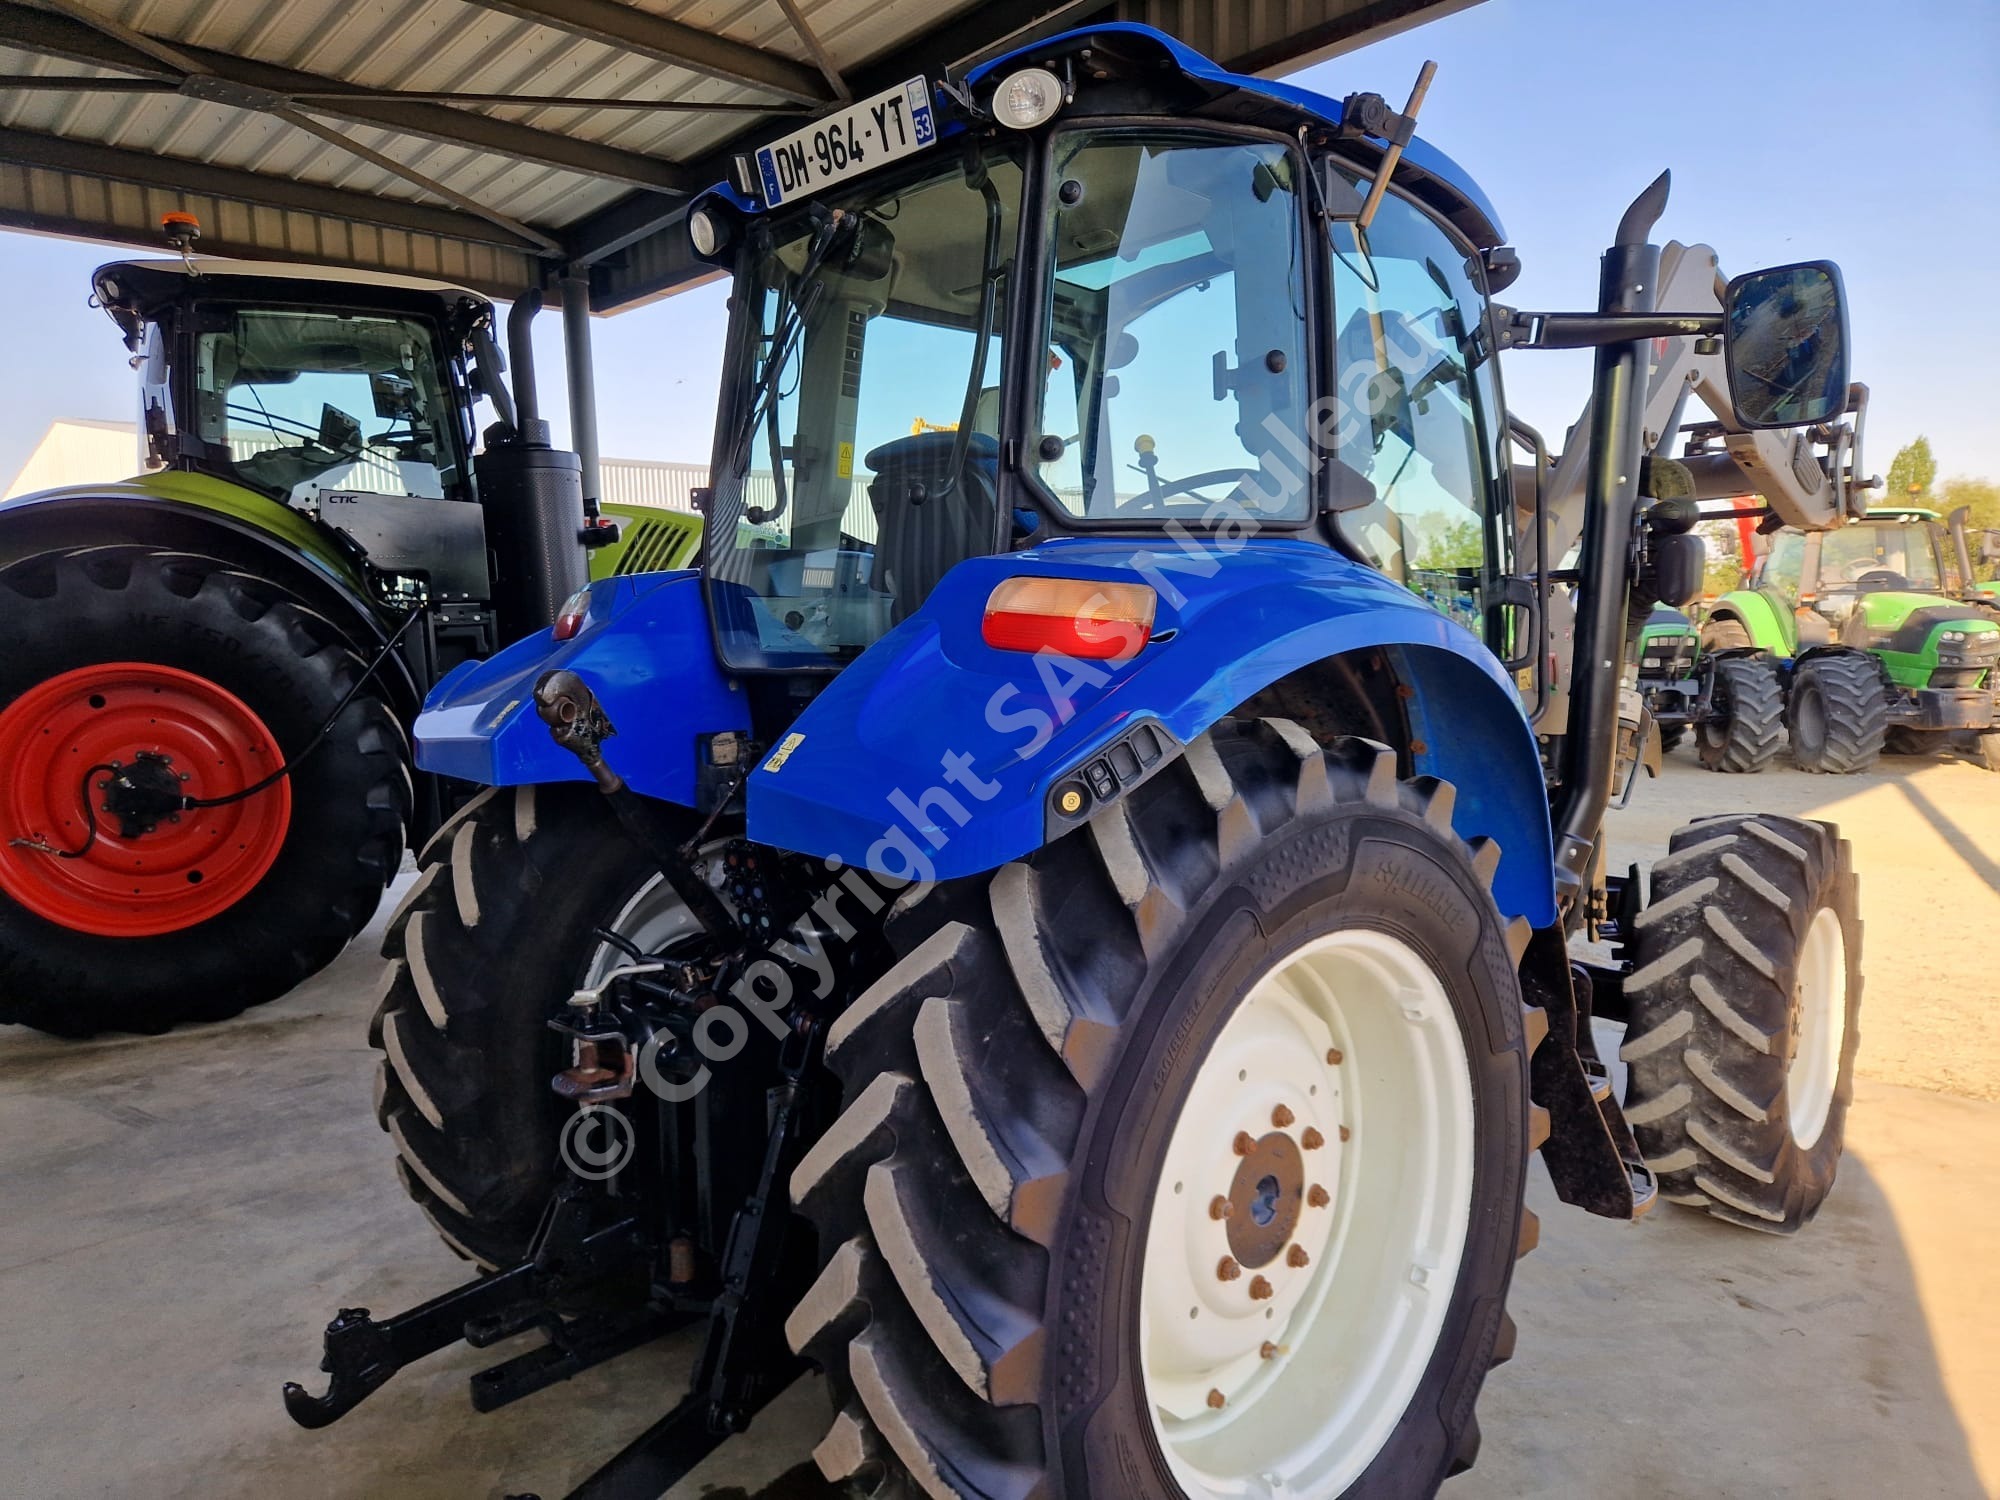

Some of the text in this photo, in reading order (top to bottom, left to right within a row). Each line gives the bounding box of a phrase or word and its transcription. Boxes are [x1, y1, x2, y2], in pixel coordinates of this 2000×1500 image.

[914, 115, 932, 140] 53
[776, 95, 906, 193] DM-964-YT
[769, 183, 775, 196] F
[329, 495, 359, 504] CTIC
